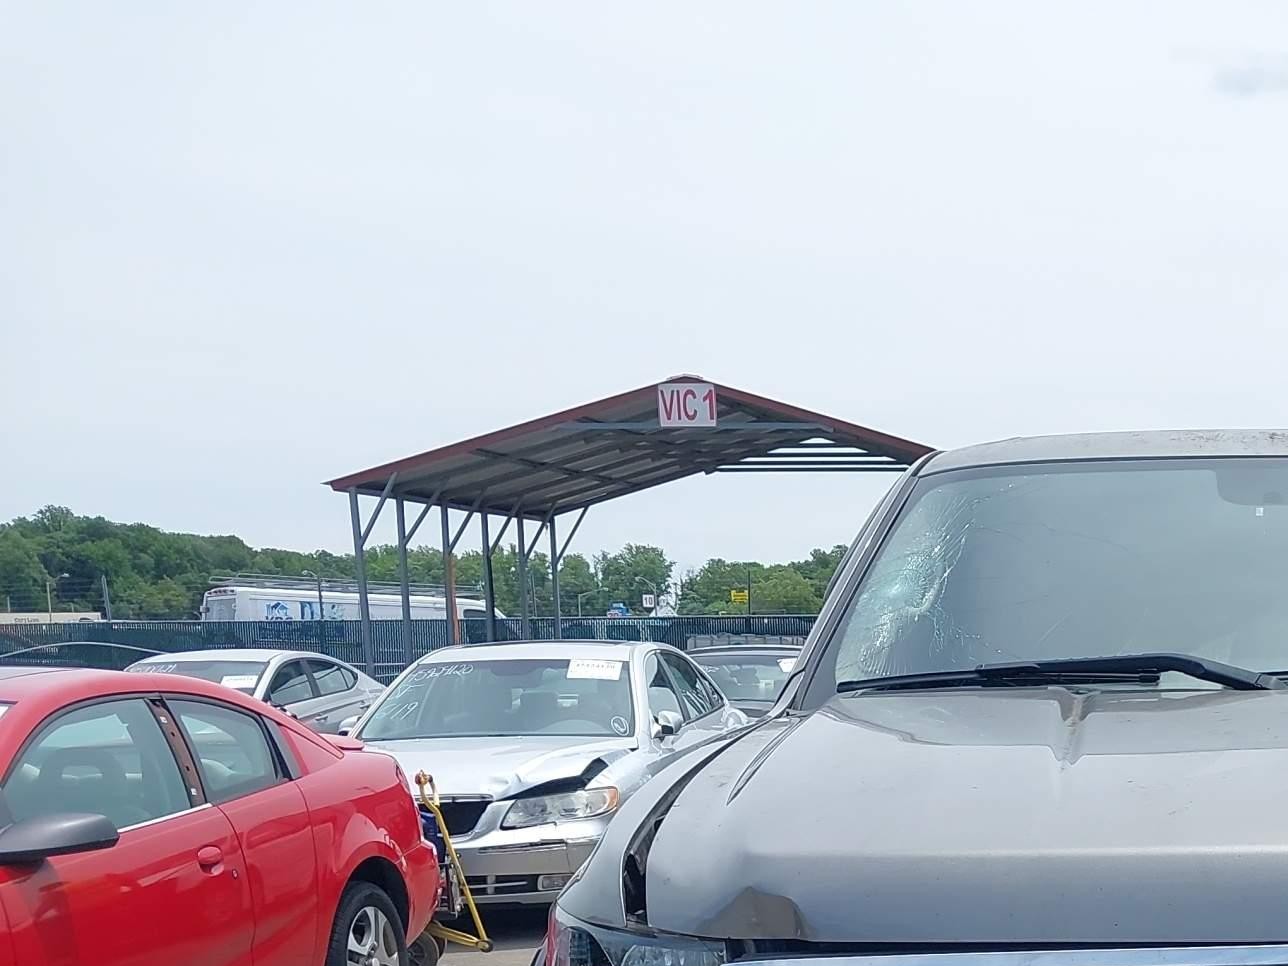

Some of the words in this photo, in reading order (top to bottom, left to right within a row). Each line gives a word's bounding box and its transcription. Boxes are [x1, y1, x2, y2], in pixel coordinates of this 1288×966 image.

[660, 389, 697, 421] VIC
[703, 389, 715, 421] 1
[644, 596, 653, 606] 10
